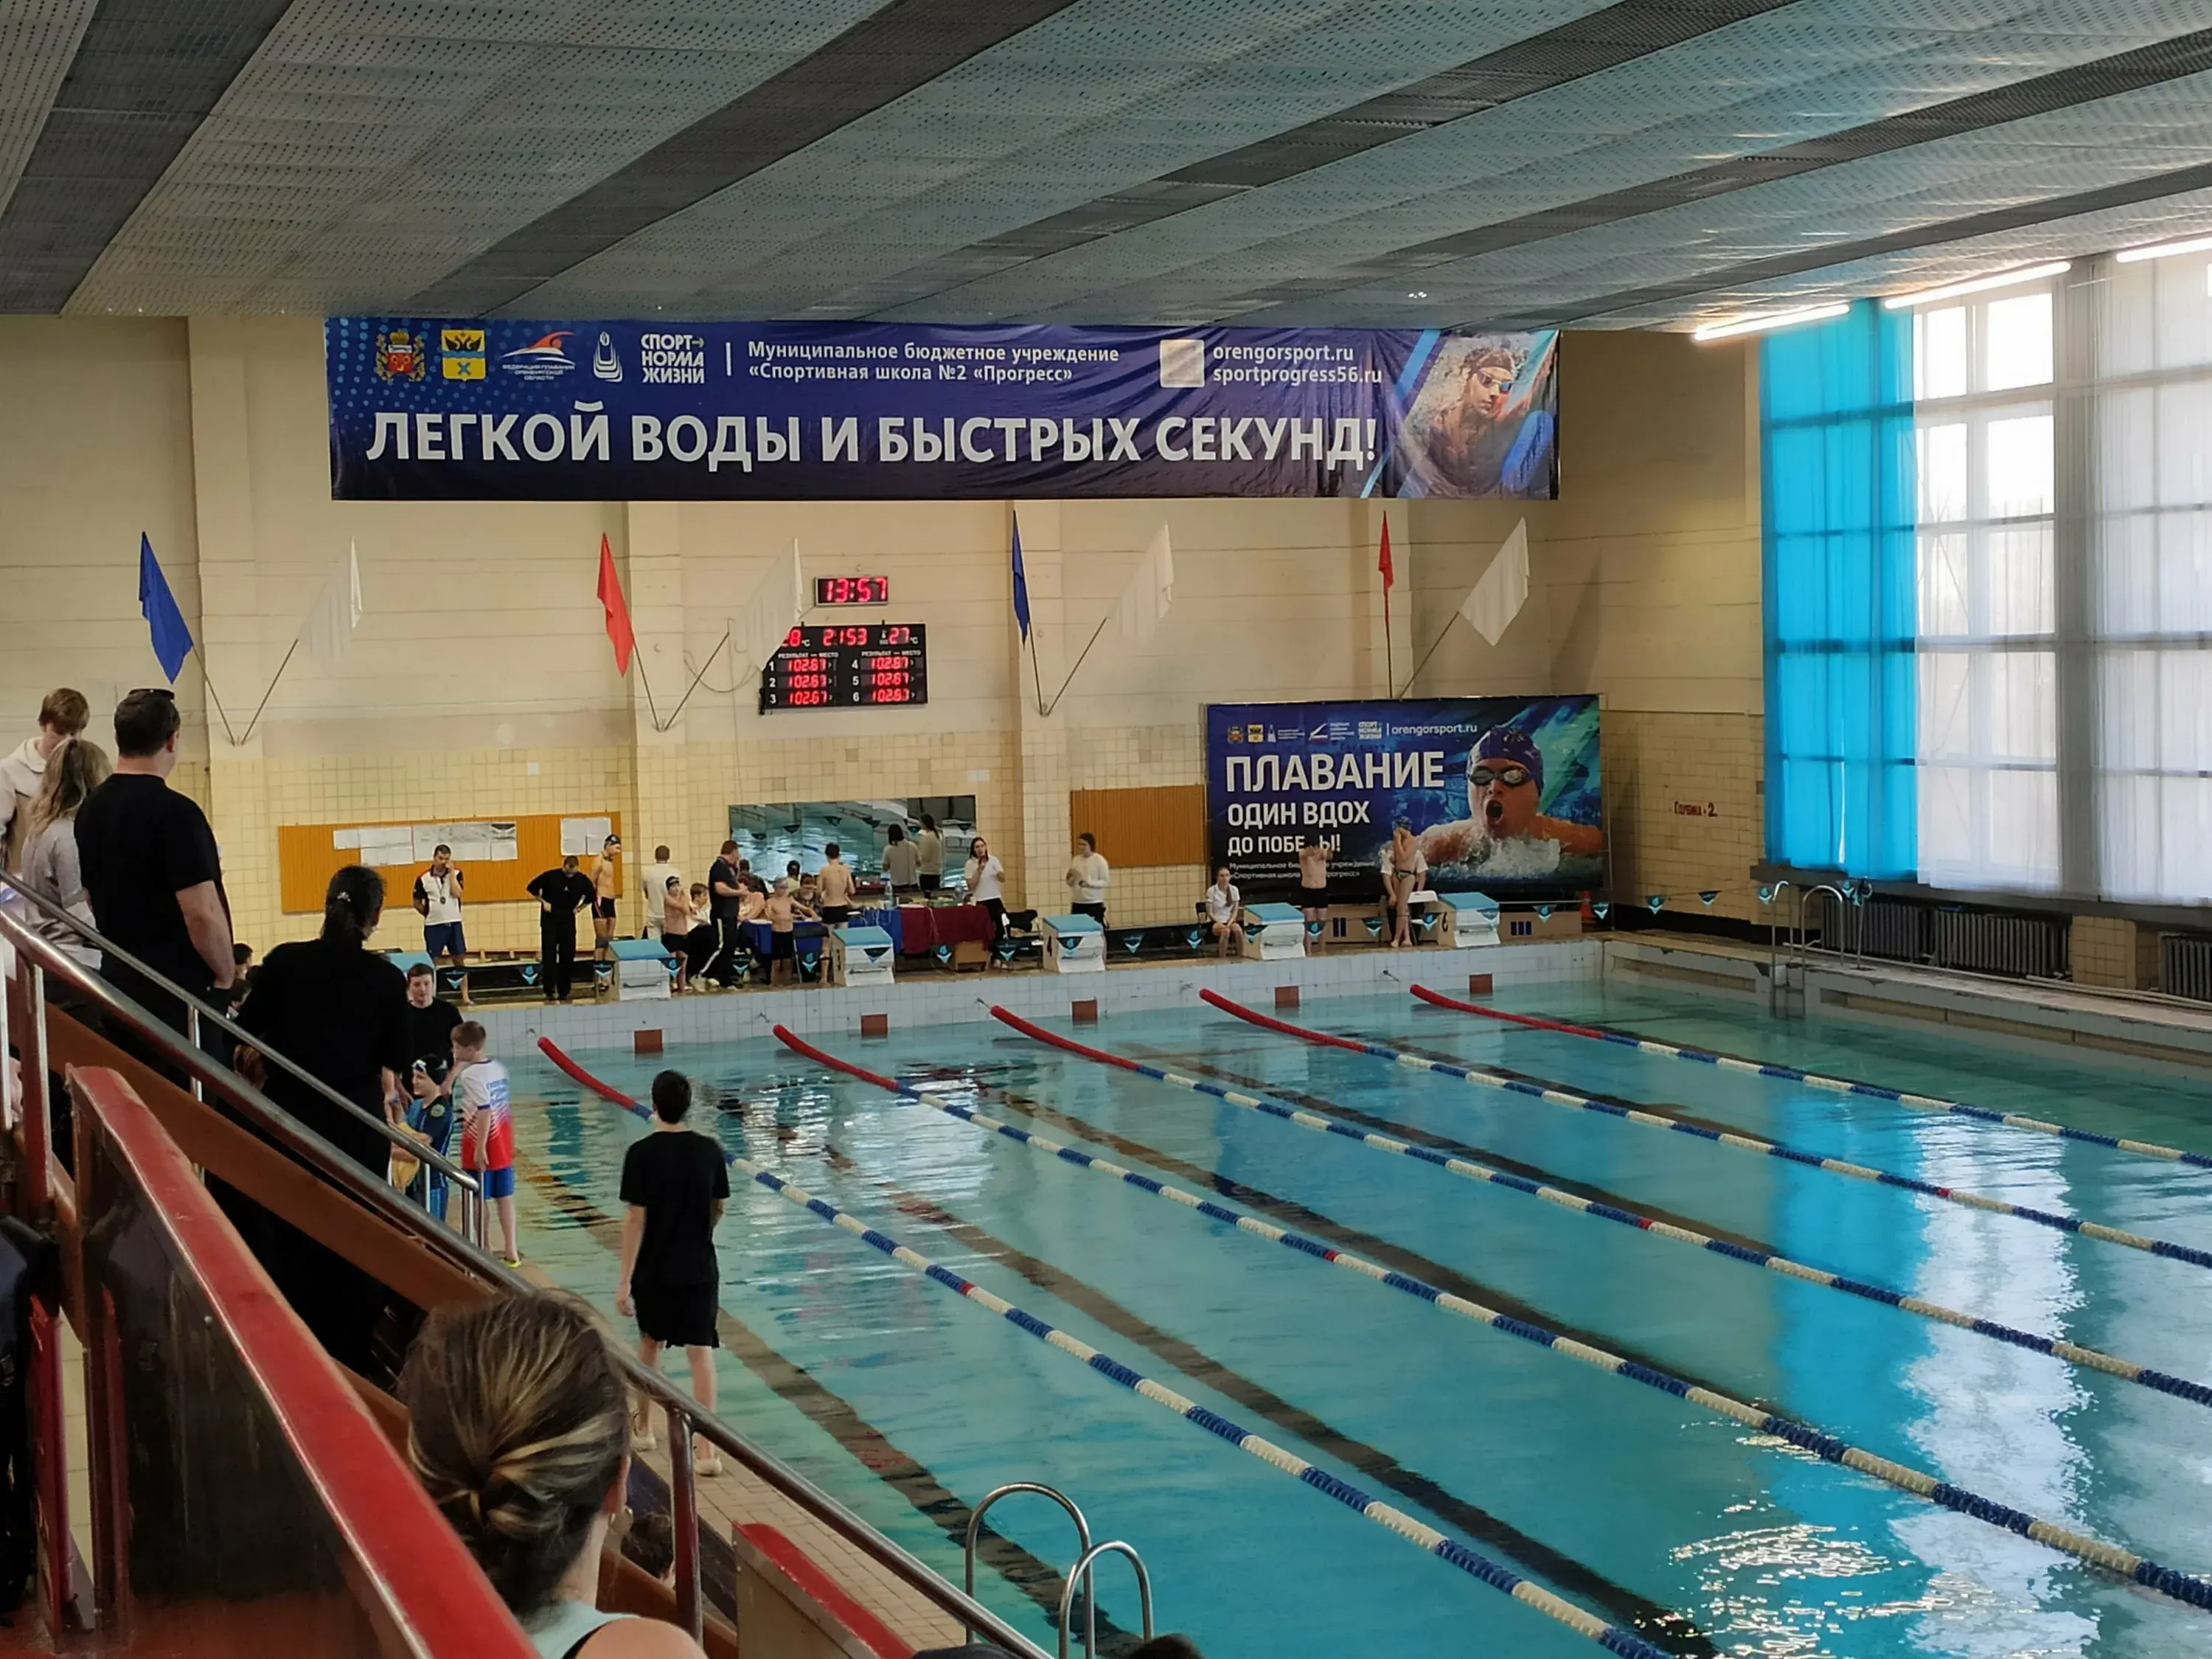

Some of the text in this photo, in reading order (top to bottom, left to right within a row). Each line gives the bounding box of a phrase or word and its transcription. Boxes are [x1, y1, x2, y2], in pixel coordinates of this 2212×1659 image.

[641, 334, 692, 350] СПОРТ
[641, 351, 704, 367] НОРМА
[748, 341, 1119, 364] Муниципальное бюджетное учреждение
[1213, 345, 1354, 364] orengorsport.ru
[642, 368, 705, 384] ЖИЗНИ
[749, 363, 1073, 384] «Спортивная школа №2 «Прогресс»
[1213, 366, 1382, 386] sportprogress56.ru
[366, 400, 1377, 473] ЛЕГКОЙ ВОДЫ И БЫСТРЫХ СЕКУНД!
[825, 576, 888, 603] 13:57
[888, 627, 911, 645] 27
[768, 661, 774, 672] 1
[851, 659, 858, 669] 4
[769, 677, 776, 687] 2
[852, 675, 859, 686] 5
[770, 694, 776, 703] 3
[852, 692, 860, 702] 6
[1391, 723, 1478, 737] orengorsport.ru
[1226, 751, 1444, 793] ПЛАВАНИЕ
[1227, 800, 1371, 830] ОДИН ВДОХ
[1228, 834, 1340, 857] ДО ПОБЕЫ!
